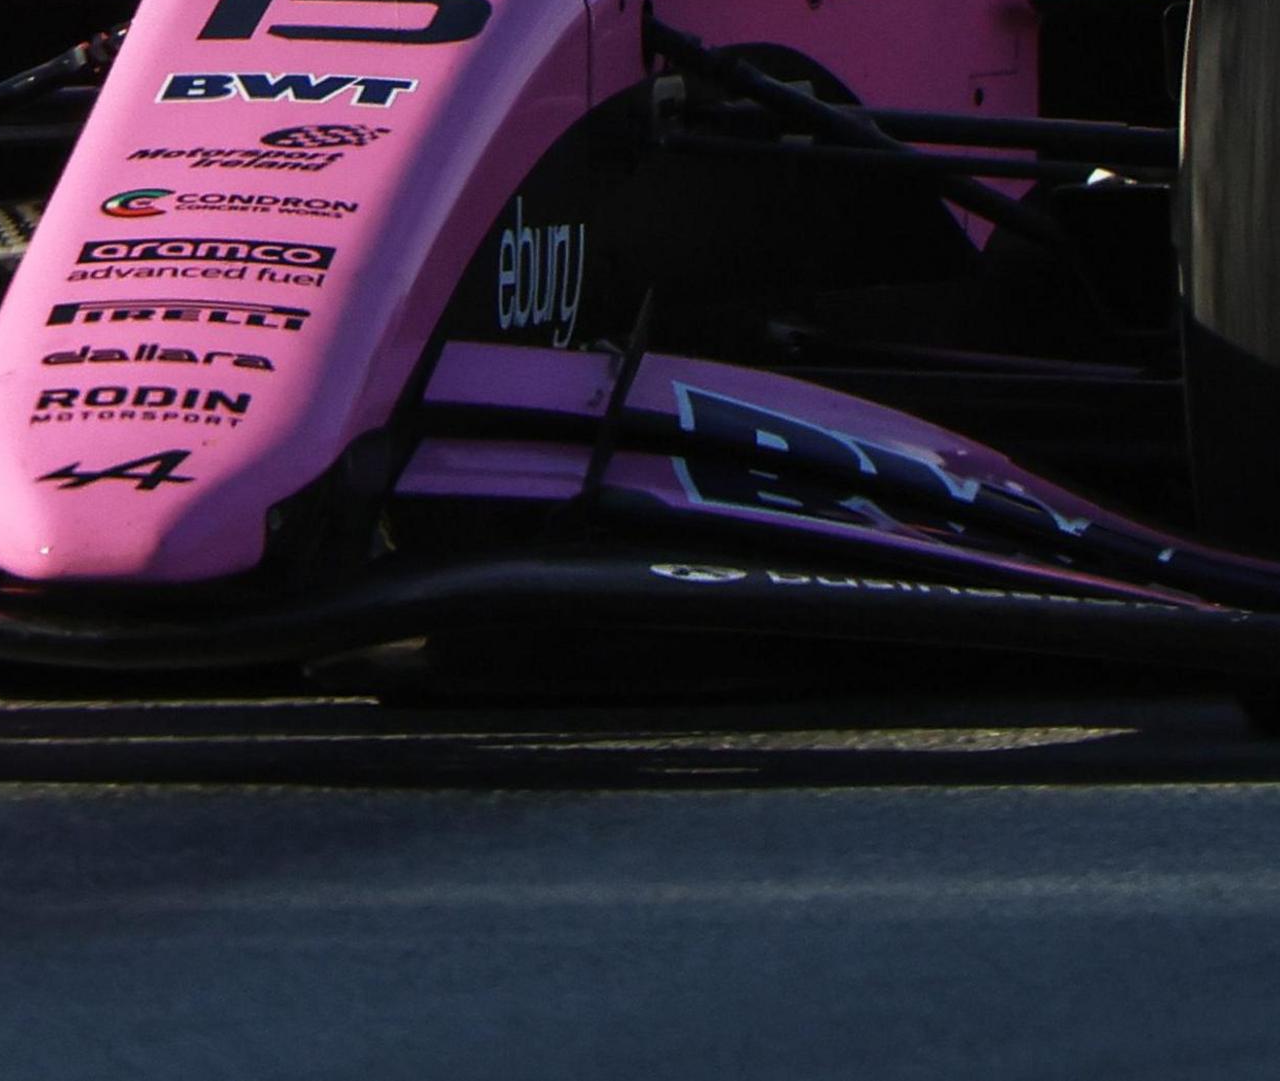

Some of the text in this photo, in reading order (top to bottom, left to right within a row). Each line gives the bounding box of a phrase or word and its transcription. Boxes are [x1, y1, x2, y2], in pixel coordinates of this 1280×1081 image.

[155, 72, 419, 108] BWT
[126, 146, 344, 165] Motorsport
[190, 156, 330, 172] Ireland
[175, 203, 343, 219] CONCRETE WORKS
[176, 193, 359, 213] CONDRON
[91, 242, 322, 264] aramco
[66, 265, 326, 287] advanced fuel
[498, 195, 585, 348] ebury
[46, 299, 311, 331] PIRELLI
[41, 343, 275, 371] dallara
[36, 386, 252, 414] RODIN
[30, 410, 244, 429] MOTORSPORT
